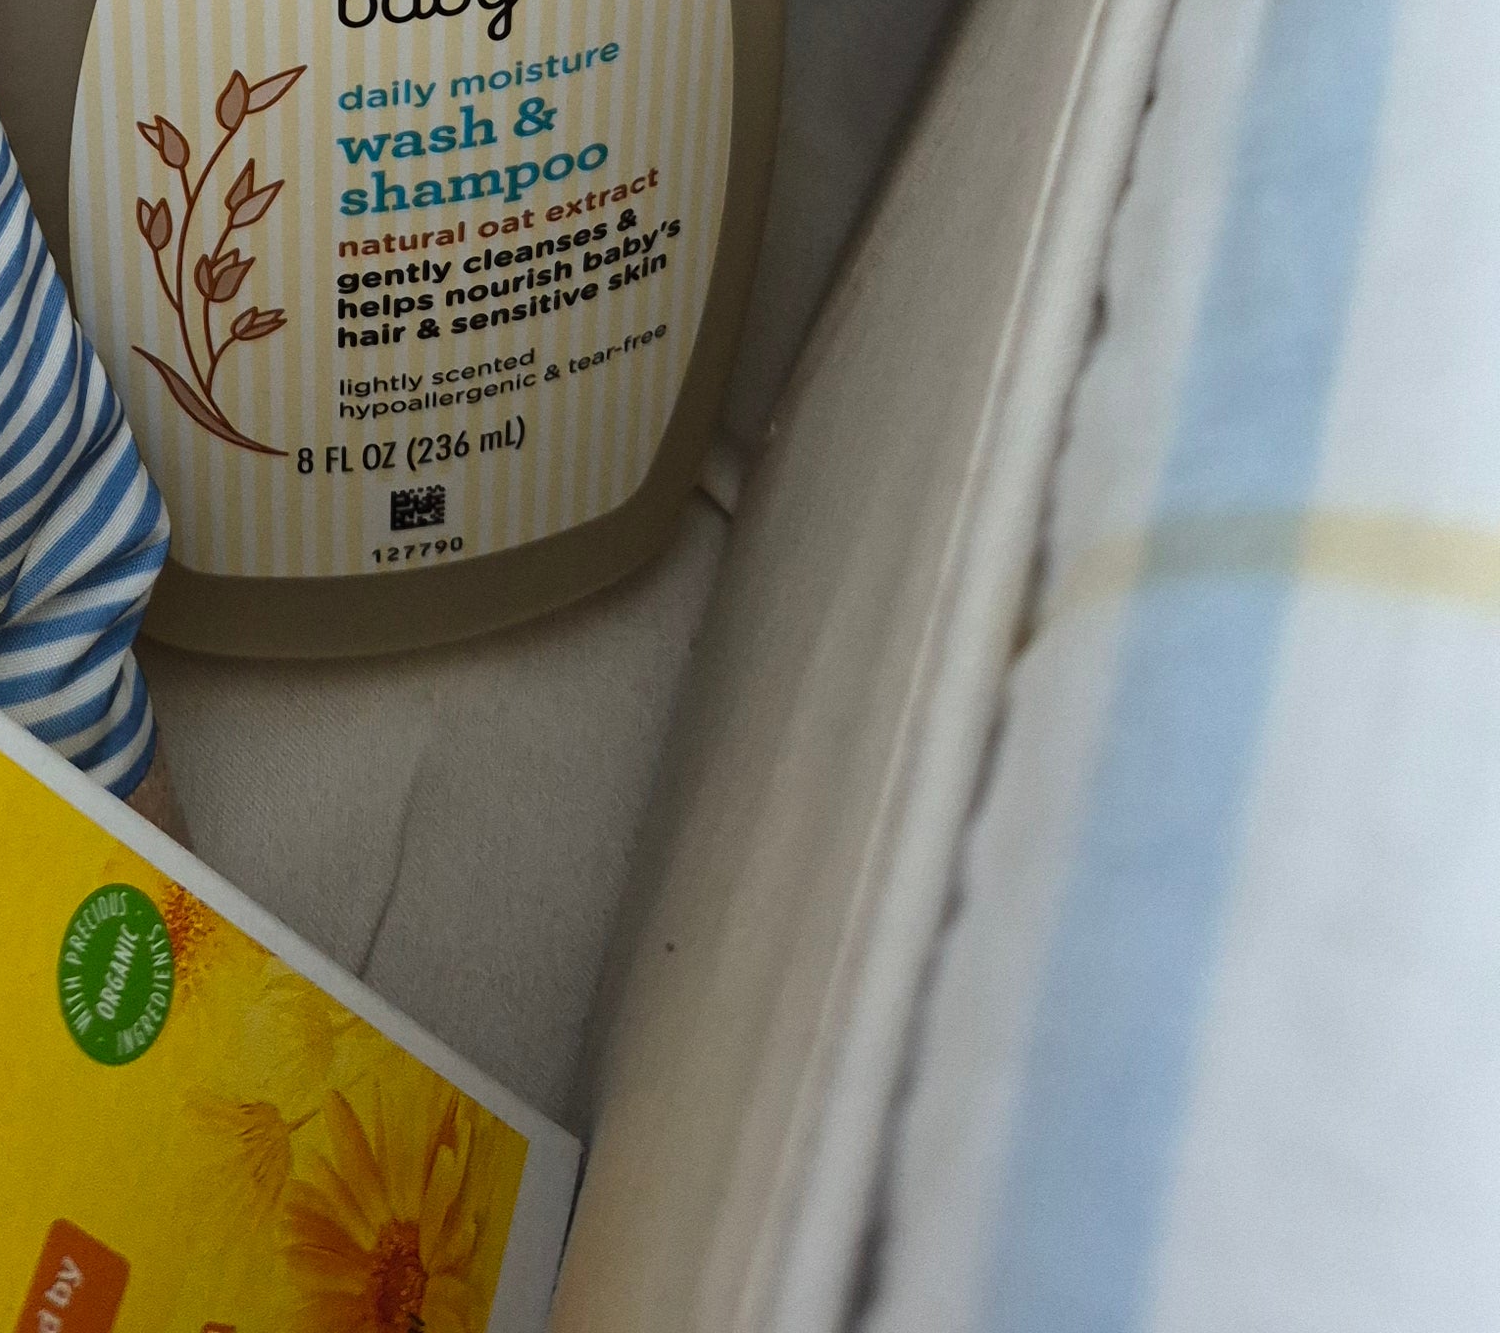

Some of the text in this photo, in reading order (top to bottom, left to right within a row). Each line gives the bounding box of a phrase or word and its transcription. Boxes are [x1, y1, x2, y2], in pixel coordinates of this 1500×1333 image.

[338, 41, 621, 111] daily moisture
[336, 96, 559, 165] wash &
[338, 167, 660, 258] natural oat extract
[339, 142, 610, 217] shampoo
[336, 208, 638, 295] gently cleanses &
[337, 218, 682, 320] helps nourish baby's
[337, 252, 668, 349] hair & sensitive skin
[338, 323, 668, 420] hypoallergenic & tear-free
[339, 347, 536, 396] lightly scented
[296, 414, 527, 475] 8 FL OZ (236 mL)
[372, 535, 464, 564] 127790
[63, 891, 130, 1036] WITH PRECIOUS
[95, 922, 140, 1021] ORGANIC
[116, 923, 172, 1056] INGREDIENTS
[44, 1255, 84, 1309] by
